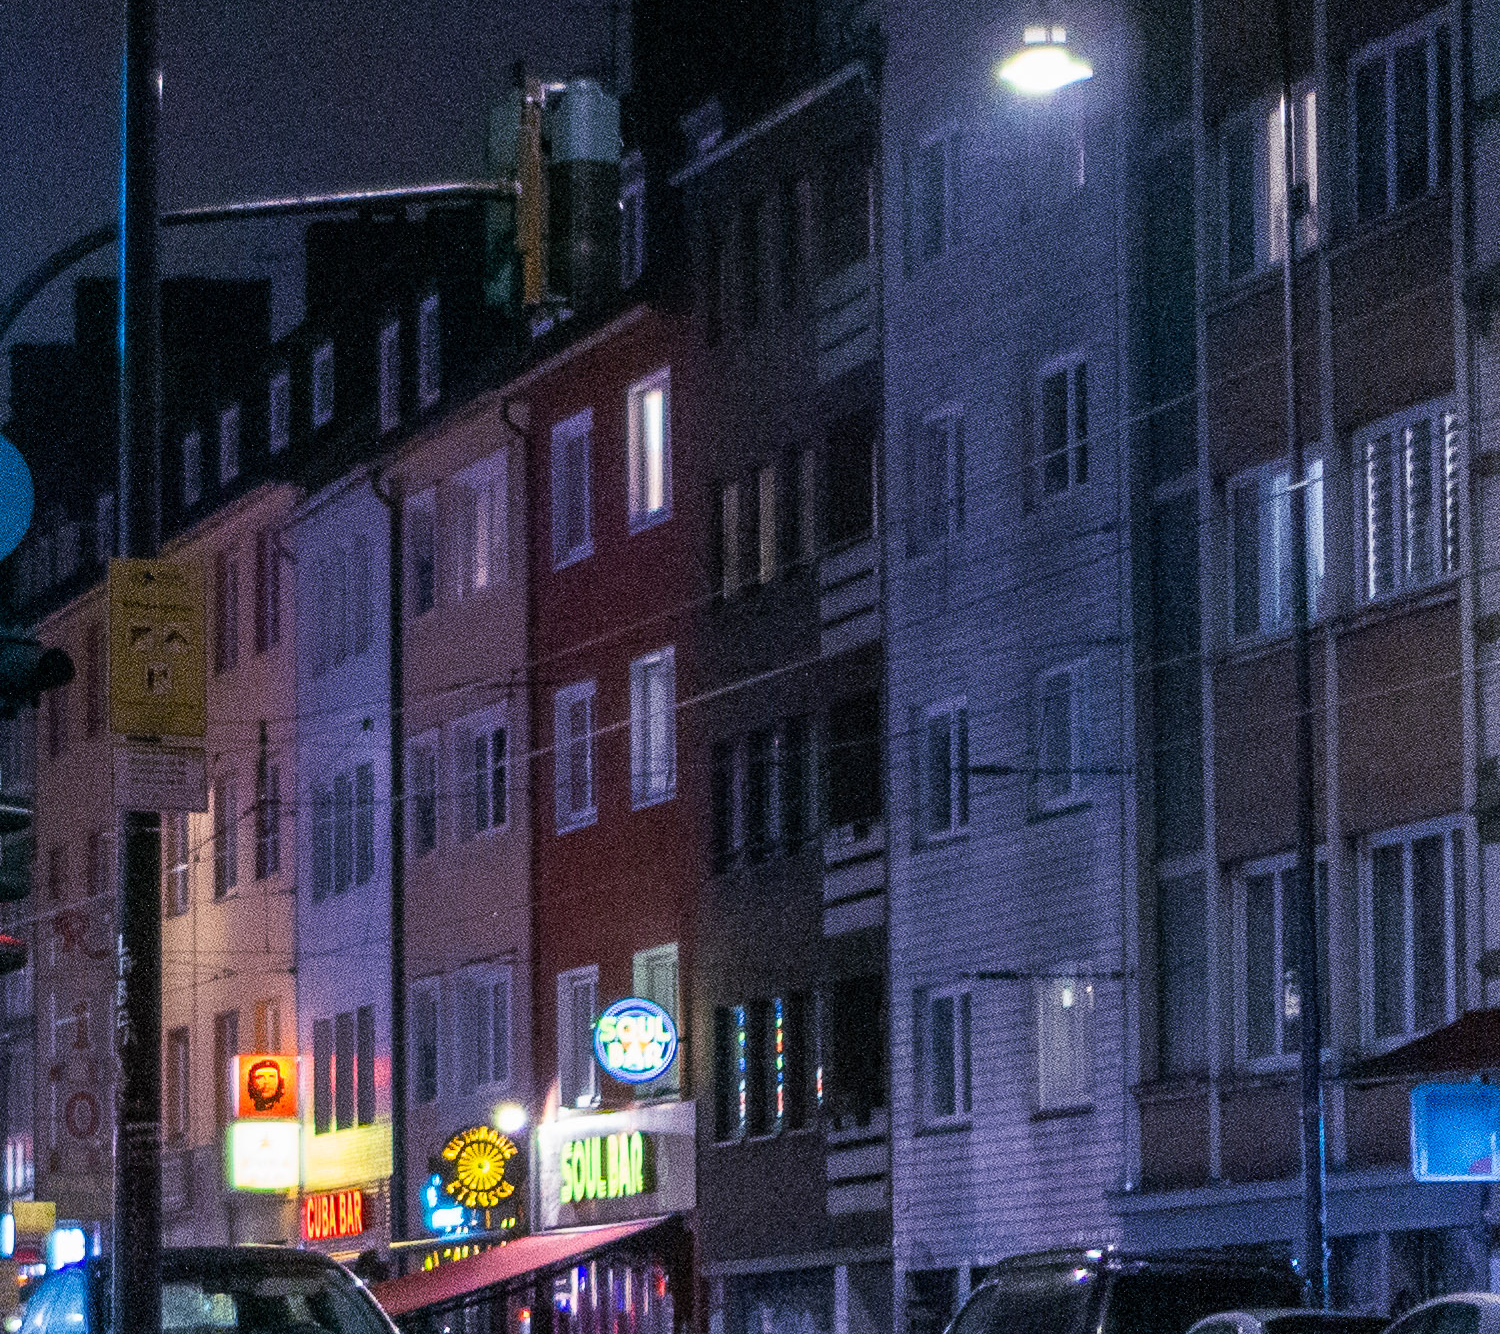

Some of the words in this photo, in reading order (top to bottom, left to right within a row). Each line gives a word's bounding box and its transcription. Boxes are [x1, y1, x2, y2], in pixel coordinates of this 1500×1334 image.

[598, 1016, 672, 1043] SOUL
[608, 1040, 665, 1069] BAR
[560, 1135, 607, 1204] SOUL
[607, 1130, 644, 1198] BAR
[306, 1193, 337, 1239] CUBA
[337, 1188, 363, 1236] BAR
